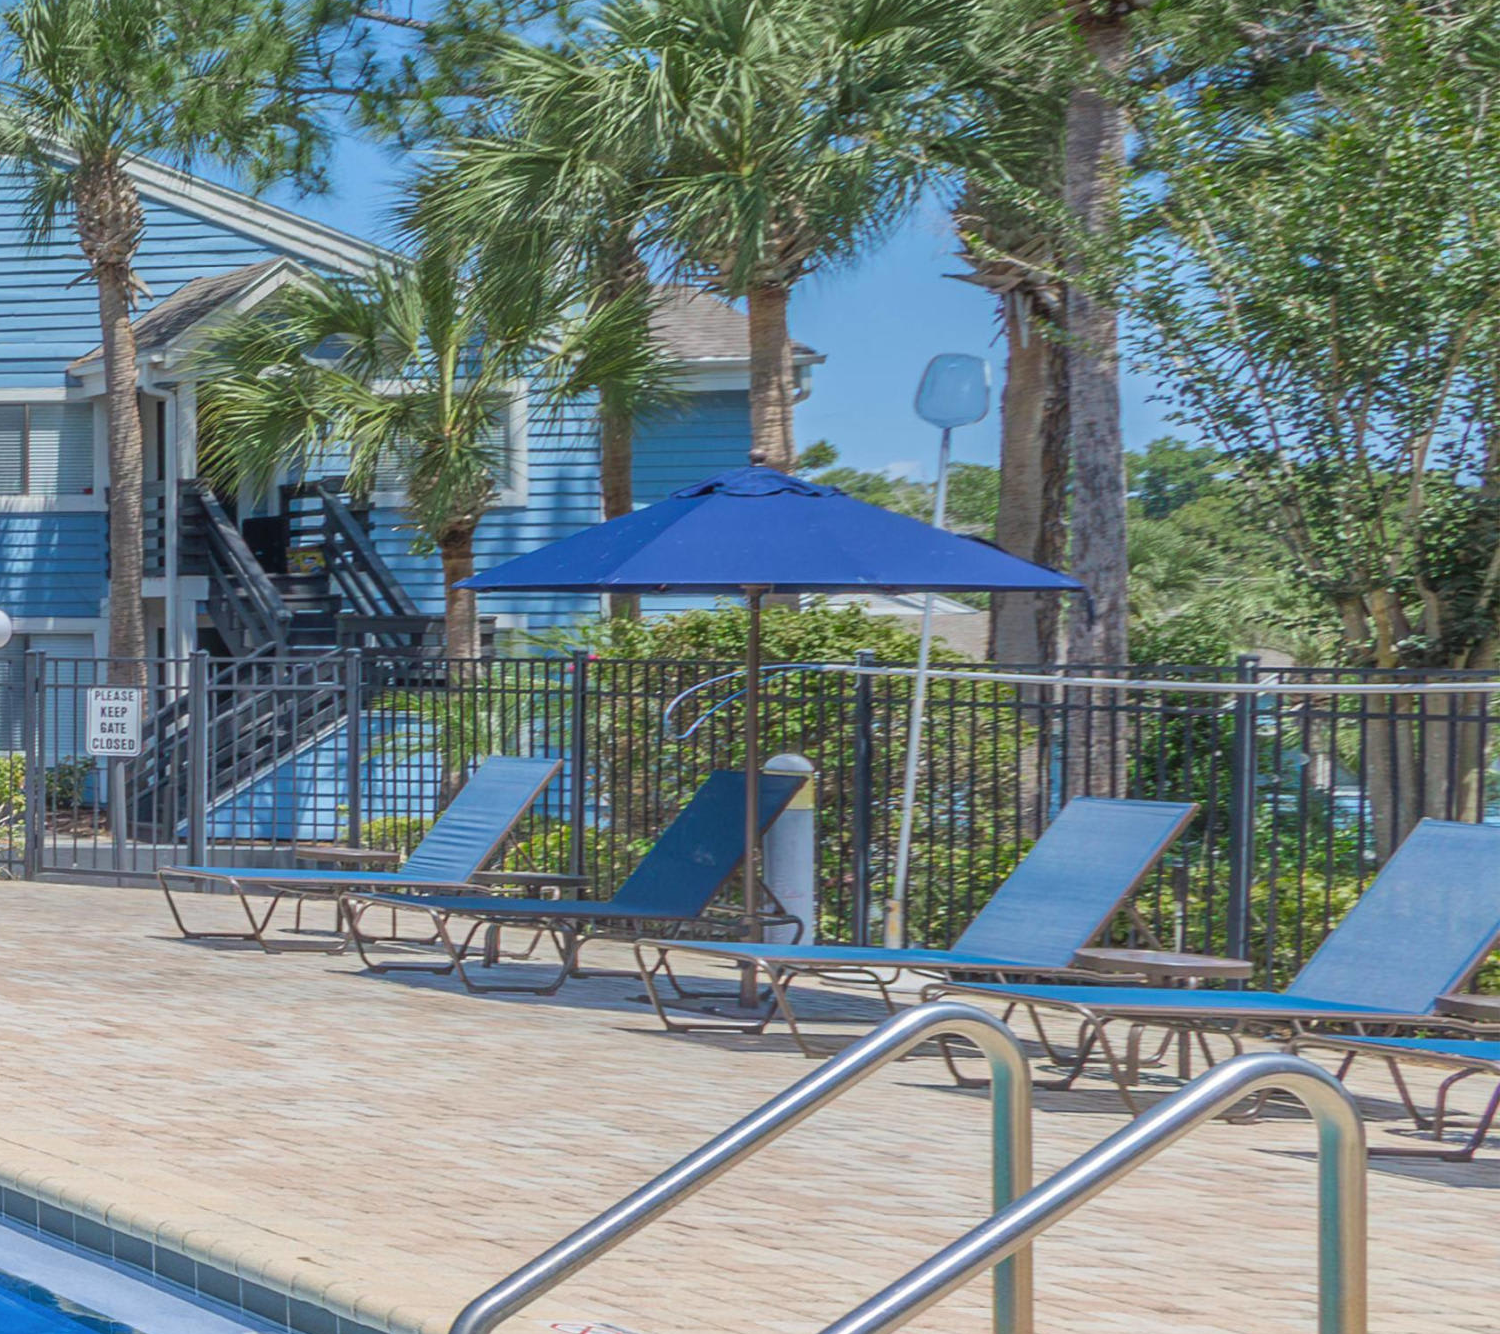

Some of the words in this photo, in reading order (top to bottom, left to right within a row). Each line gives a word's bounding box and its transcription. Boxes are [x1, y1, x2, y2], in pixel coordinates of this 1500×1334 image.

[94, 690, 134, 702] PLEASE
[100, 706, 128, 718] KEEP
[100, 722, 127, 734] GATE
[92, 738, 135, 750] CLOSED
